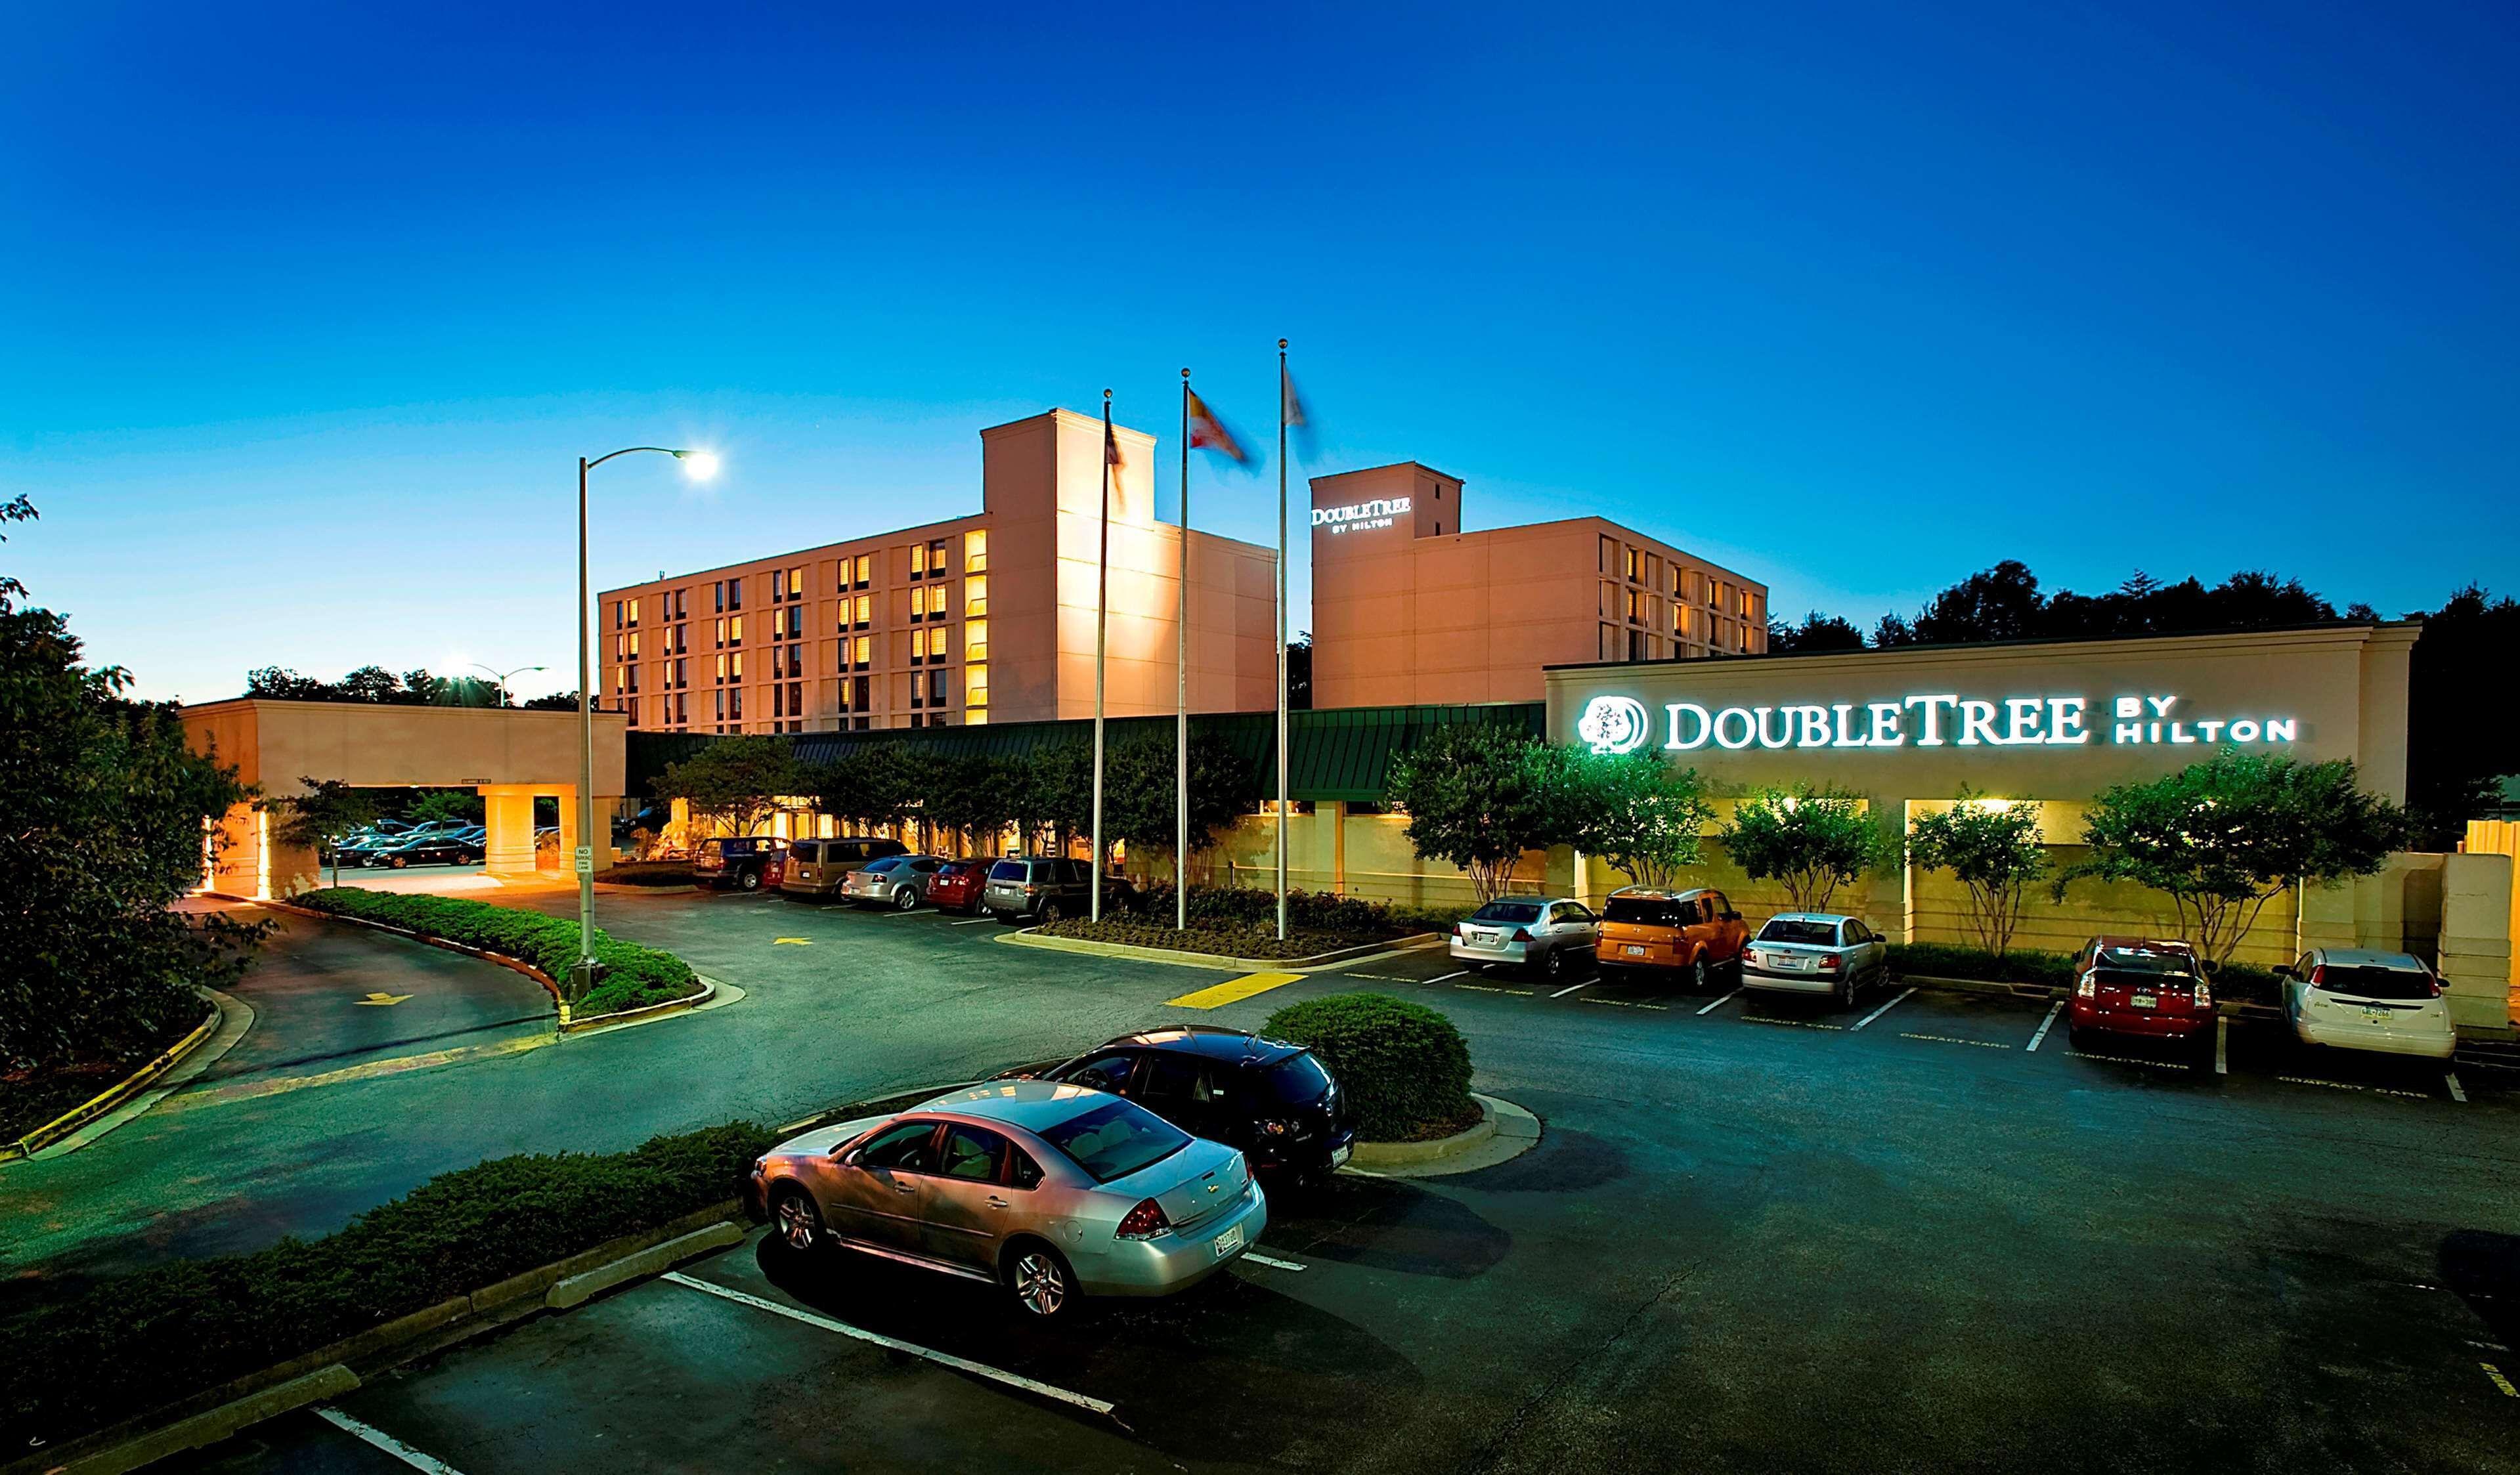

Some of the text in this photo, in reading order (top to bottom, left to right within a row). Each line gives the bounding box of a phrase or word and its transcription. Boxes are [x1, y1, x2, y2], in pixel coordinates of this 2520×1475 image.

[1332, 518, 1393, 534] BY HILTON
[2116, 696, 2177, 717] BY
[2116, 719, 2296, 743] HILTON
[1900, 1033, 1965, 1043] COMPACT
[2064, 1052, 2142, 1063] COMPACT
[2278, 1076, 2428, 1098] COMPACT CARS
